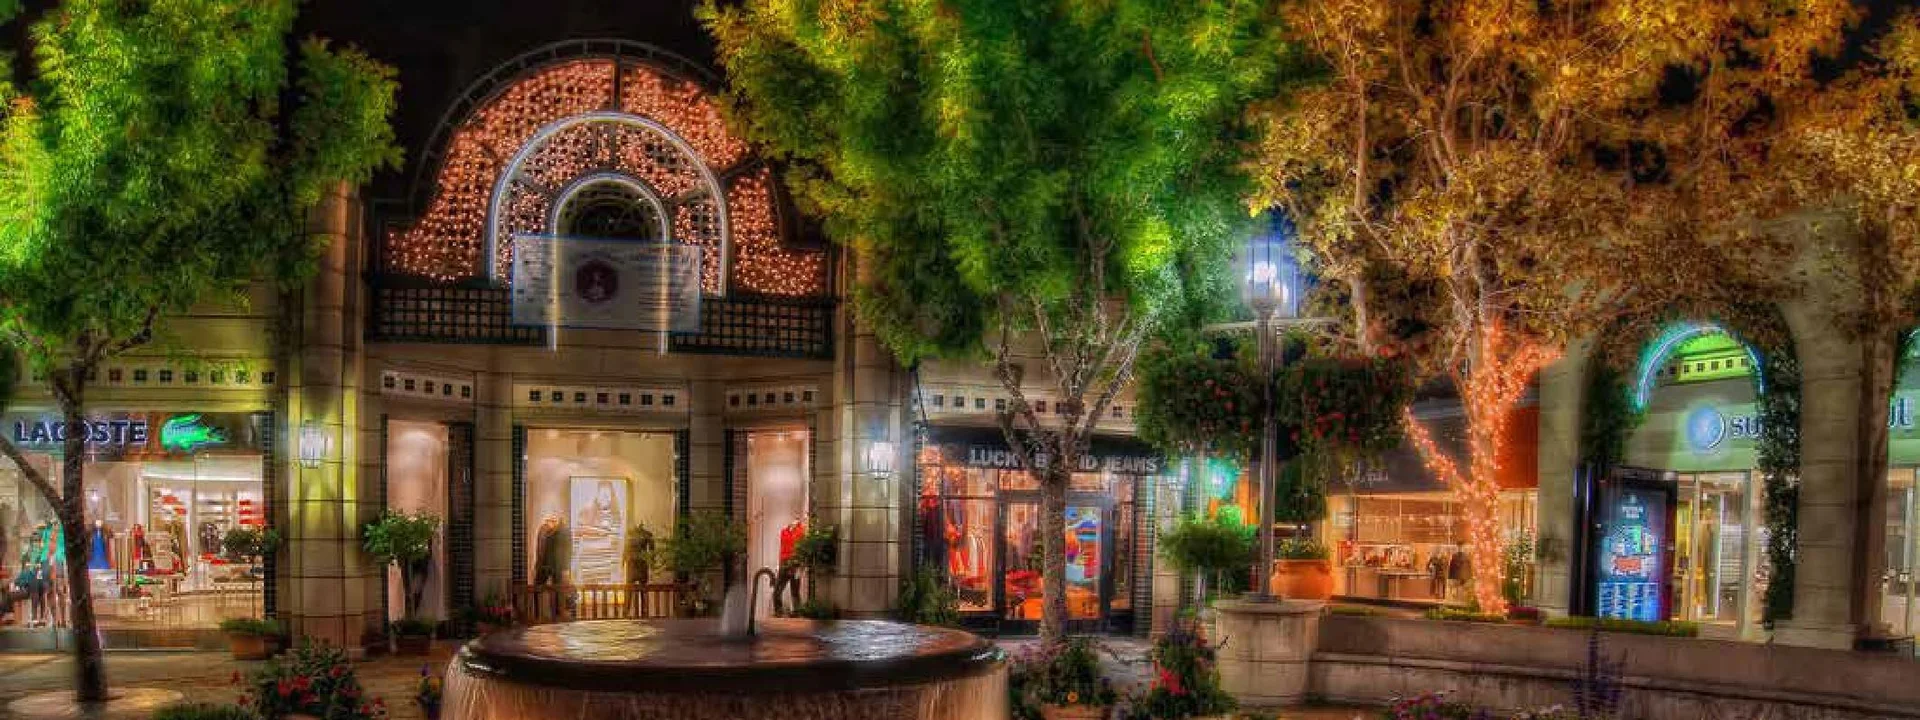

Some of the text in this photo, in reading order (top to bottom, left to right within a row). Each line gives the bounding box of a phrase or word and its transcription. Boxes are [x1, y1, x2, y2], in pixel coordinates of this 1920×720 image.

[969, 447, 1159, 472] LUCK BND JEANS
